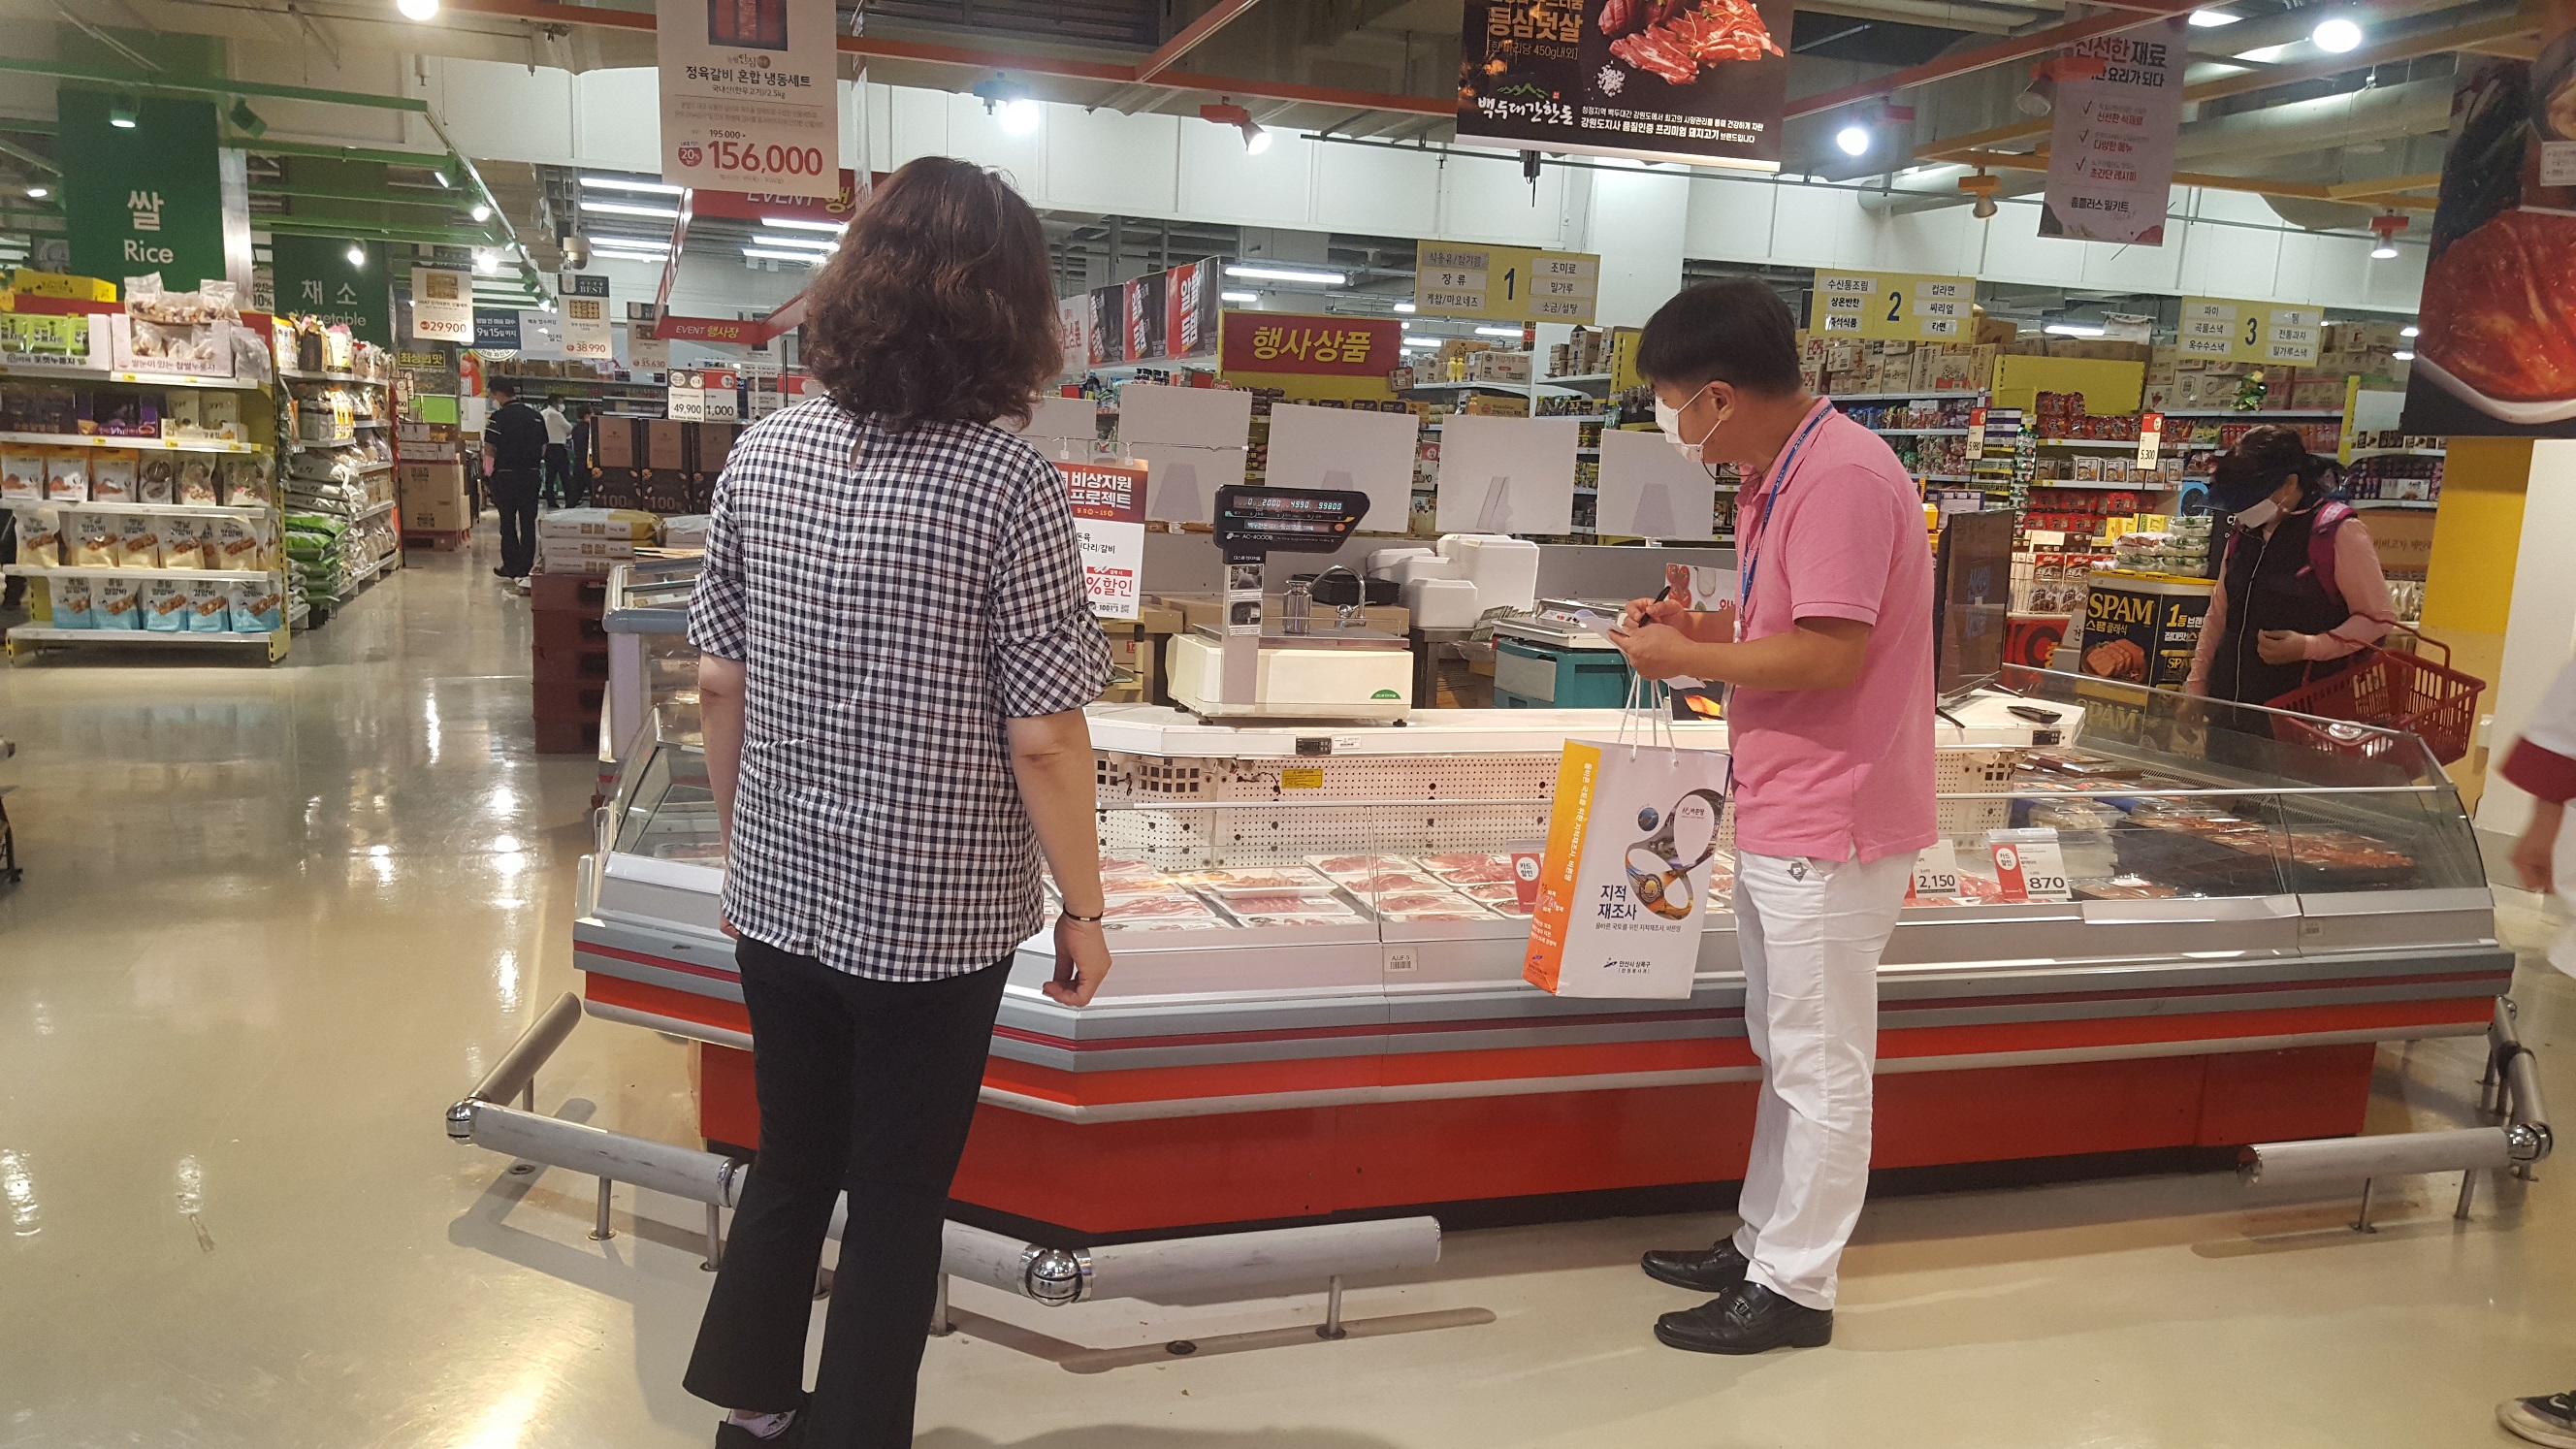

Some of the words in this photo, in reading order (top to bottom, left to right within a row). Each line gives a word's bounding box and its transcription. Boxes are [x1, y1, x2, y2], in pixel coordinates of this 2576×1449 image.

[1489, 7, 1583, 43] 등심덧살
[2130, 41, 2167, 69] 재료
[686, 66, 733, 81] 정육갈비
[737, 70, 760, 84] 혼합
[764, 73, 813, 87] 냉동세트
[2108, 67, 2141, 85] 요리가
[2141, 71, 2165, 87] 되다
[1477, 97, 1573, 126] 백두대간한돈
[1582, 106, 1607, 115] 청정지역
[1607, 109, 1632, 118] 백두대간
[1633, 111, 1663, 121] 강원도에서
[1664, 113, 1683, 123] 최고의
[1727, 119, 1752, 130] 건강하게
[1581, 117, 1621, 131] 강원도지사
[1622, 122, 1654, 134] 품질인증
[1656, 124, 1687, 137] 프리미엄
[1689, 127, 1720, 140] 돼지고기
[1720, 133, 1755, 144] 브랜드입니다
[707, 140, 823, 177] 156,000
[127, 189, 164, 232] 쌀
[2072, 197, 2104, 210] 홈플러스
[2105, 200, 2129, 212] 밀키트
[123, 240, 175, 264] Rice
[1551, 262, 1577, 274] 조미료
[1504, 268, 1515, 301] 1
[1551, 281, 1574, 294] 밀가루
[1827, 279, 1869, 292] 수산통조림
[1932, 284, 1955, 296] 컵라면
[1427, 293, 1478, 307] 케찹/마요네즈
[1831, 297, 1860, 308] 상온반찬
[1542, 303, 1578, 315] 소금/설탕
[1886, 292, 1902, 322] 2
[1929, 304, 1954, 315] 씨리얼
[2204, 306, 2219, 316] 파이
[296, 308, 367, 327] Vgetable
[430, 321, 467, 334] 29,900
[676, 326, 705, 335] EVENT
[707, 326, 740, 338] 행사장
[1932, 322, 1947, 333] 라면
[2195, 323, 2224, 335] 곡물스낵
[2245, 317, 2258, 346] 3
[2278, 328, 2306, 340] 전통과자
[576, 343, 606, 353] 38,990
[1252, 326, 1371, 365] 행사상품
[2188, 339, 2225, 353] 옥수수스낵
[2272, 346, 2308, 358] 밀가루스낵
[157, 361, 173, 370] 있는
[674, 403, 701, 414] 49,900
[2140, 449, 2155, 461] 5,300
[1072, 471, 1132, 493] 비상지원
[1069, 489, 1131, 509] 프로젝트
[1079, 542, 1115, 554] 다리/갈비
[2087, 593, 2154, 626] SPAM
[2167, 604, 2187, 628] 1등
[2085, 620, 2106, 632] 스팸
[1521, 869, 1533, 878] 할인
[1918, 875, 1955, 888] 2,150
[2029, 877, 2066, 889] 870
[1600, 885, 1626, 901] 지적
[1597, 903, 1637, 920] 재조사
[1595, 921, 1611, 930] 올바른
